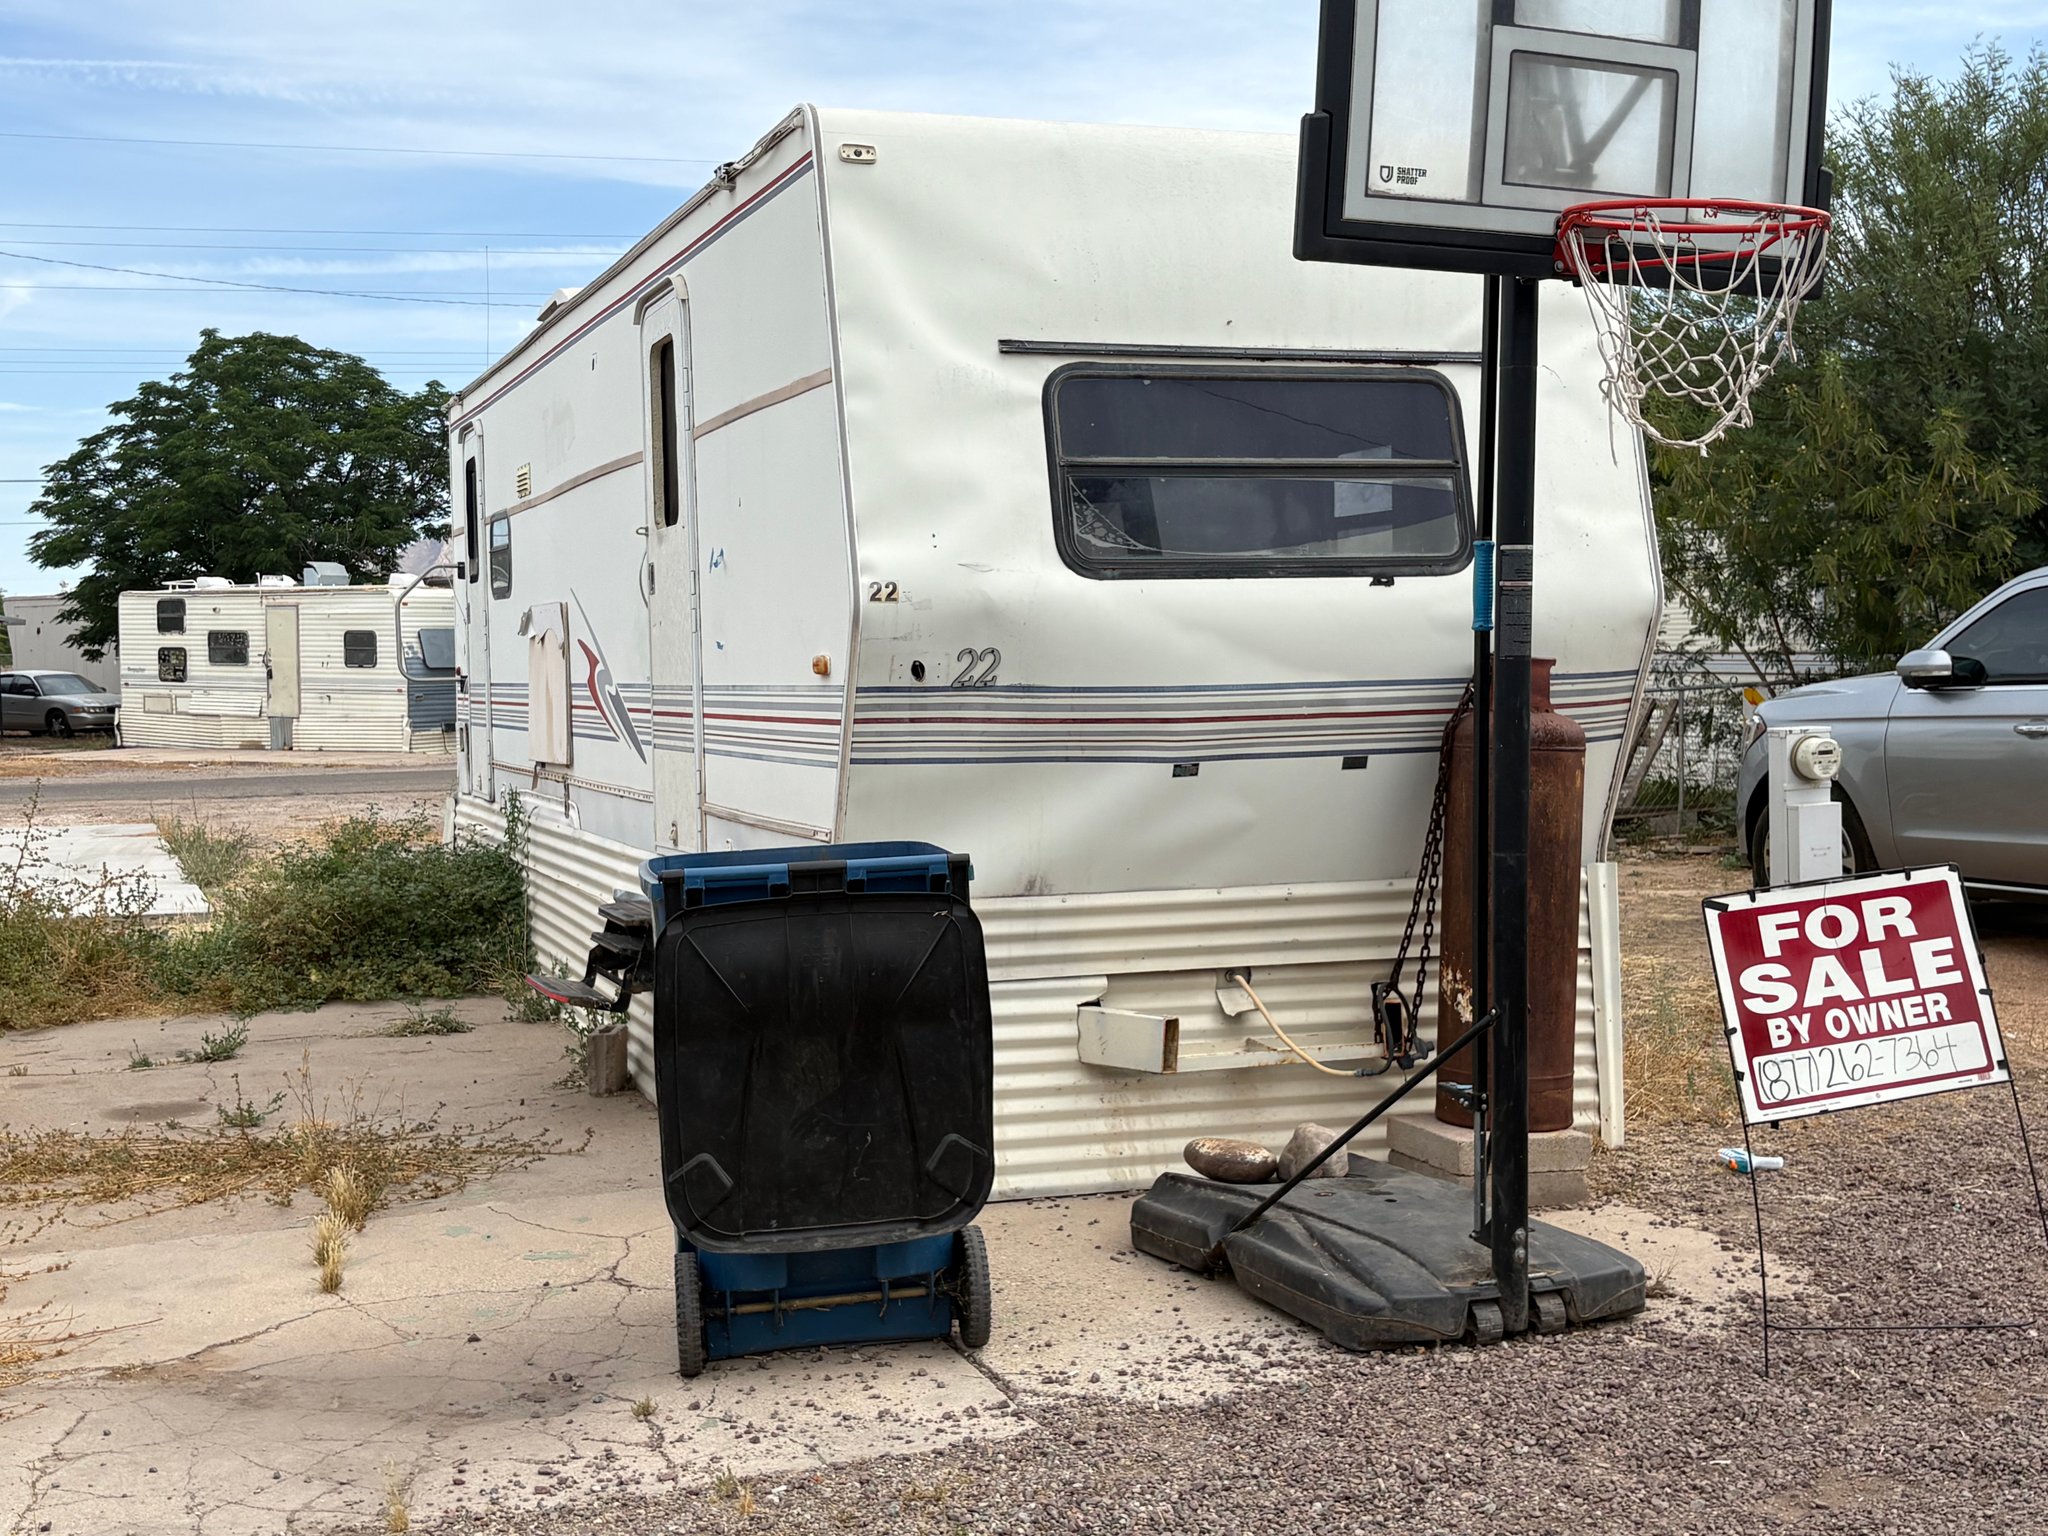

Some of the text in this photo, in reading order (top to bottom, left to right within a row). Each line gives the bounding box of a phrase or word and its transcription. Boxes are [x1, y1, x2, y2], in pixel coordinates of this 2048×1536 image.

[1396, 175, 1419, 185] PROOF
[1397, 166, 1427, 177] SHATTER
[869, 580, 898, 602] 22
[950, 647, 1002, 688] 22
[1757, 896, 1918, 958] FOR
[1739, 936, 1964, 1015] SALE
[1766, 992, 1953, 1049] BY OWNER
